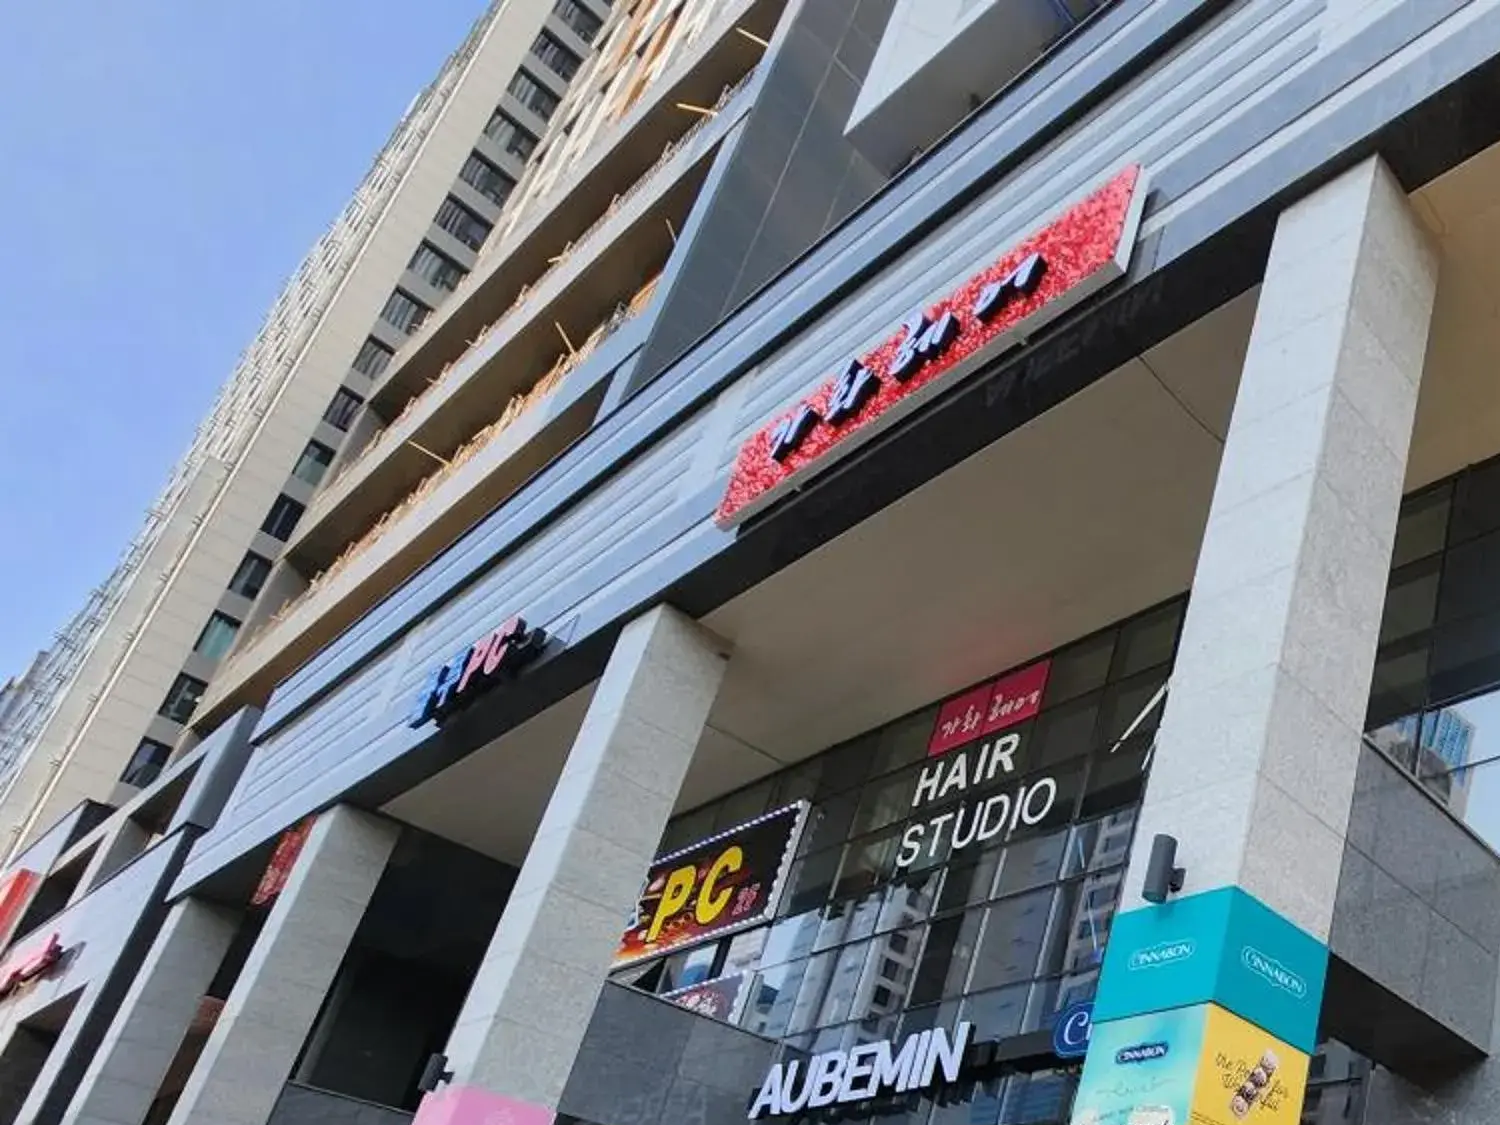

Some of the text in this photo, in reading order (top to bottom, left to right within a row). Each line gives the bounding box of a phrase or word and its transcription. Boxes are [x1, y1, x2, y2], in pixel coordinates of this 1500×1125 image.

[911, 732, 1021, 808] HAIR
[895, 777, 1058, 868] STUDIO
[645, 845, 744, 943] PC
[1132, 942, 1192, 966] CINNABON
[1245, 948, 1304, 994] CINNABON
[748, 1020, 973, 1121] AUBEMIN
